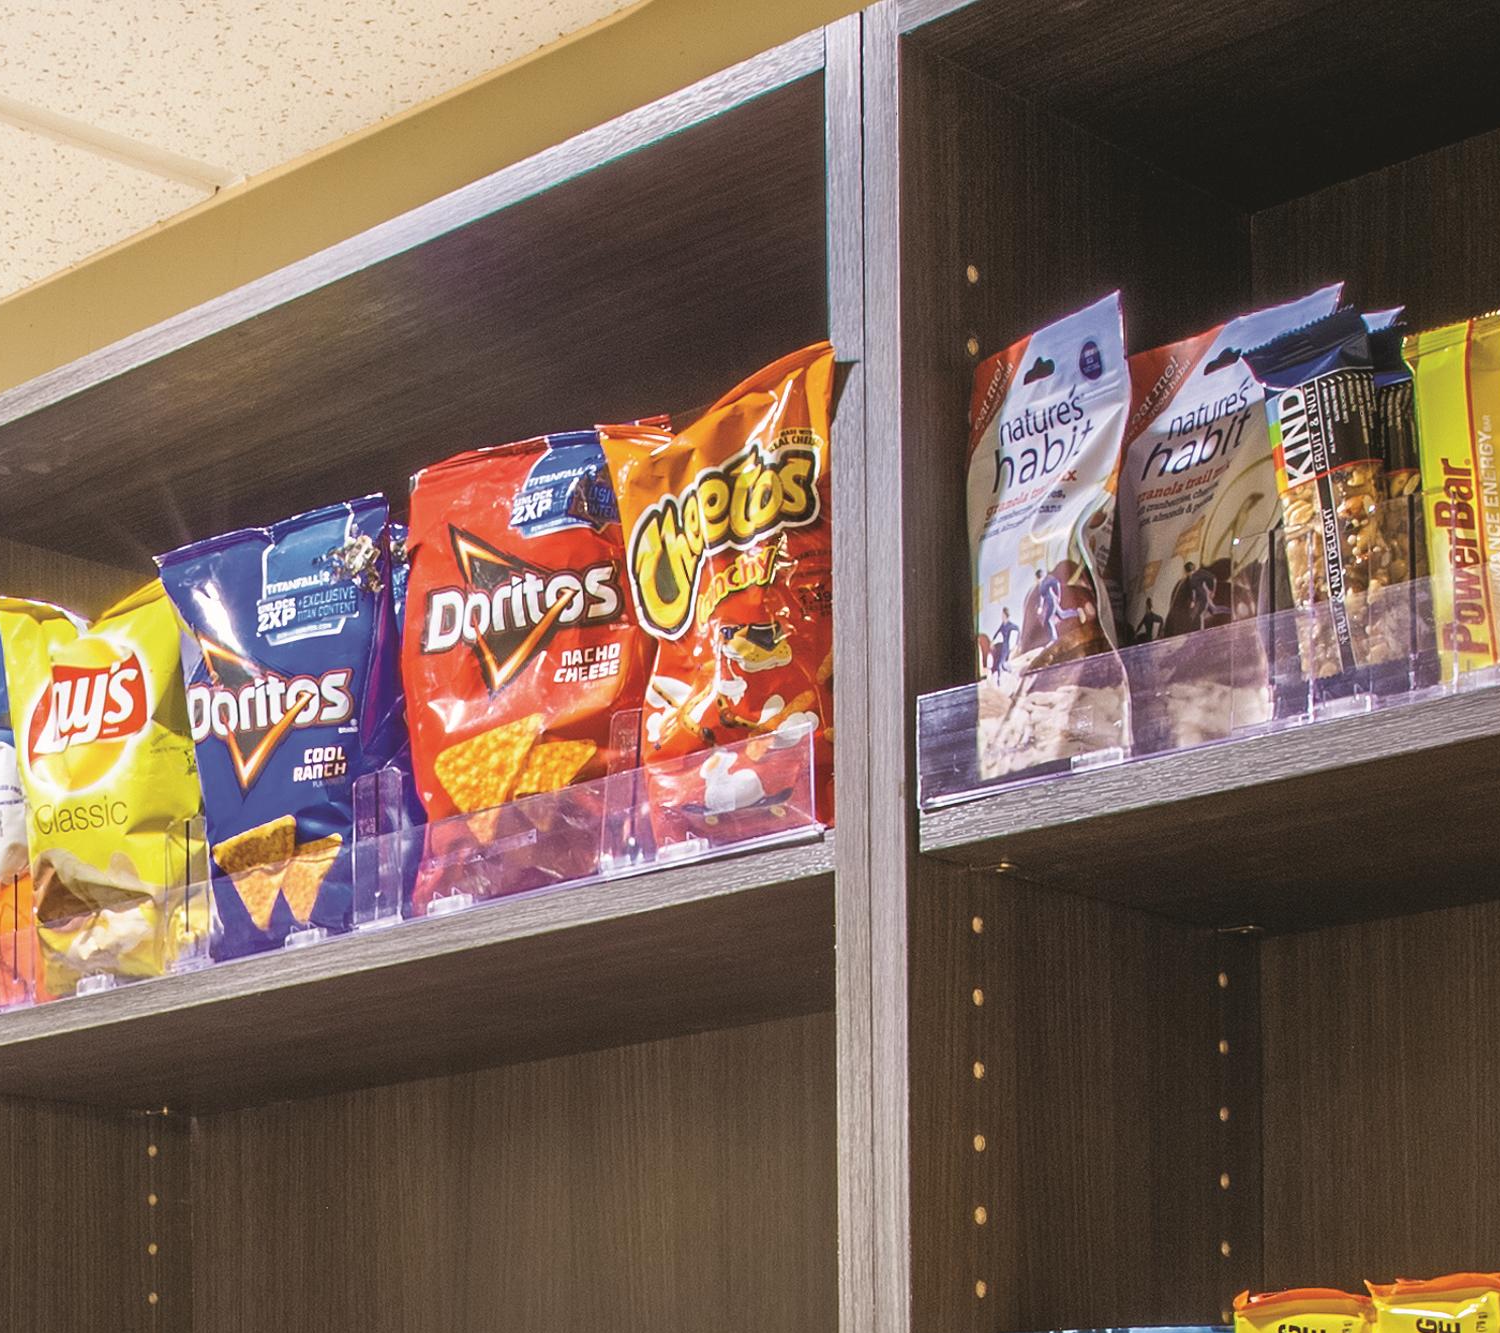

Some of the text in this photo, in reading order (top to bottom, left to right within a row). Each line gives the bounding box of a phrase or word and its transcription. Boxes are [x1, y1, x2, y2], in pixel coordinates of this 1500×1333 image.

[1141, 410, 1251, 481] habit
[1278, 387, 1316, 488] KIND
[1304, 386, 1324, 471] FRUIT NUT
[635, 451, 814, 631] Cheetos
[1322, 510, 1337, 563] DELIGHT
[258, 610, 296, 632] 2XP
[427, 565, 616, 653] Doritos
[553, 661, 619, 683] CHEESE
[562, 644, 620, 667] NACHO
[31, 662, 138, 753] Lay's
[189, 672, 350, 740] Doritos
[293, 762, 346, 782] RANCH
[304, 746, 345, 764] COOL
[35, 796, 128, 836] Classic
